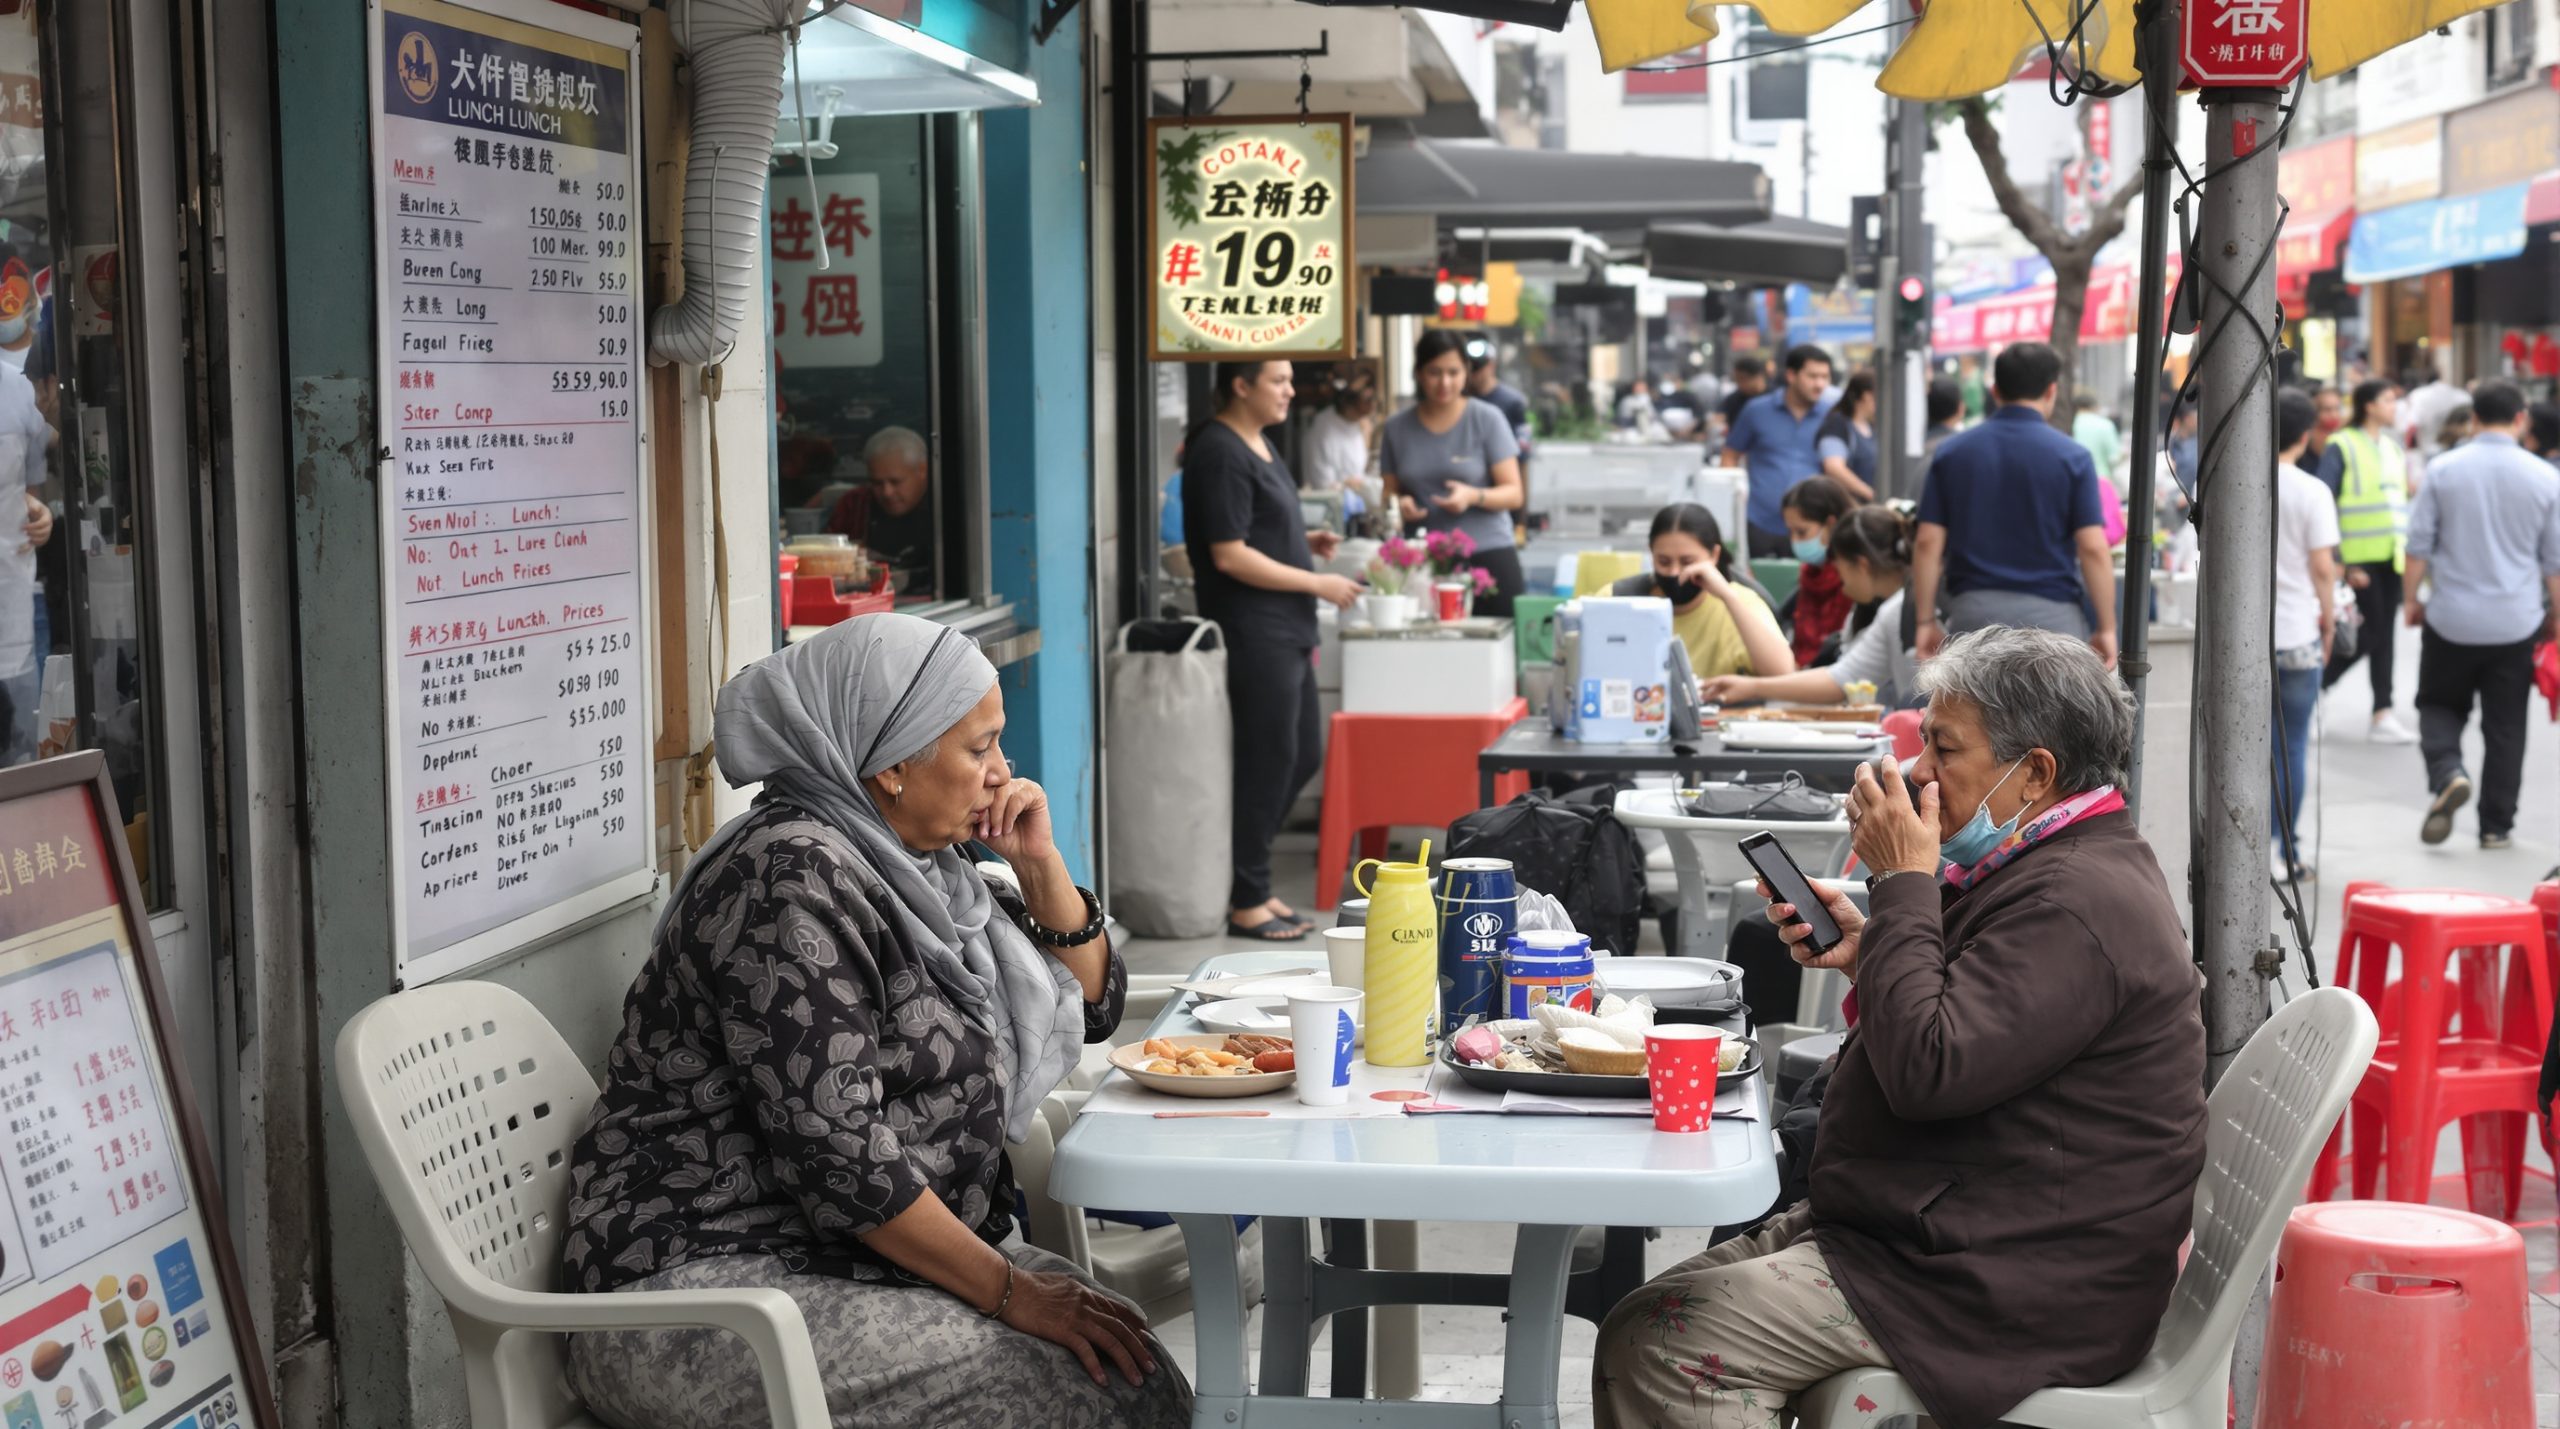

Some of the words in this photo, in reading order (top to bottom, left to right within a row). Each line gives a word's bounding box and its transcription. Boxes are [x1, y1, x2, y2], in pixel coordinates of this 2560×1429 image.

[448, 97, 503, 125] LUNCH
[509, 108, 561, 134] LUNCH
[597, 182, 624, 201] 50.0
[598, 211, 626, 232] 50.0
[532, 236, 556, 254] 100
[456, 298, 486, 319] Long
[599, 305, 627, 324] 50.0
[462, 566, 504, 588] Lunch
[563, 603, 604, 623] Prices
